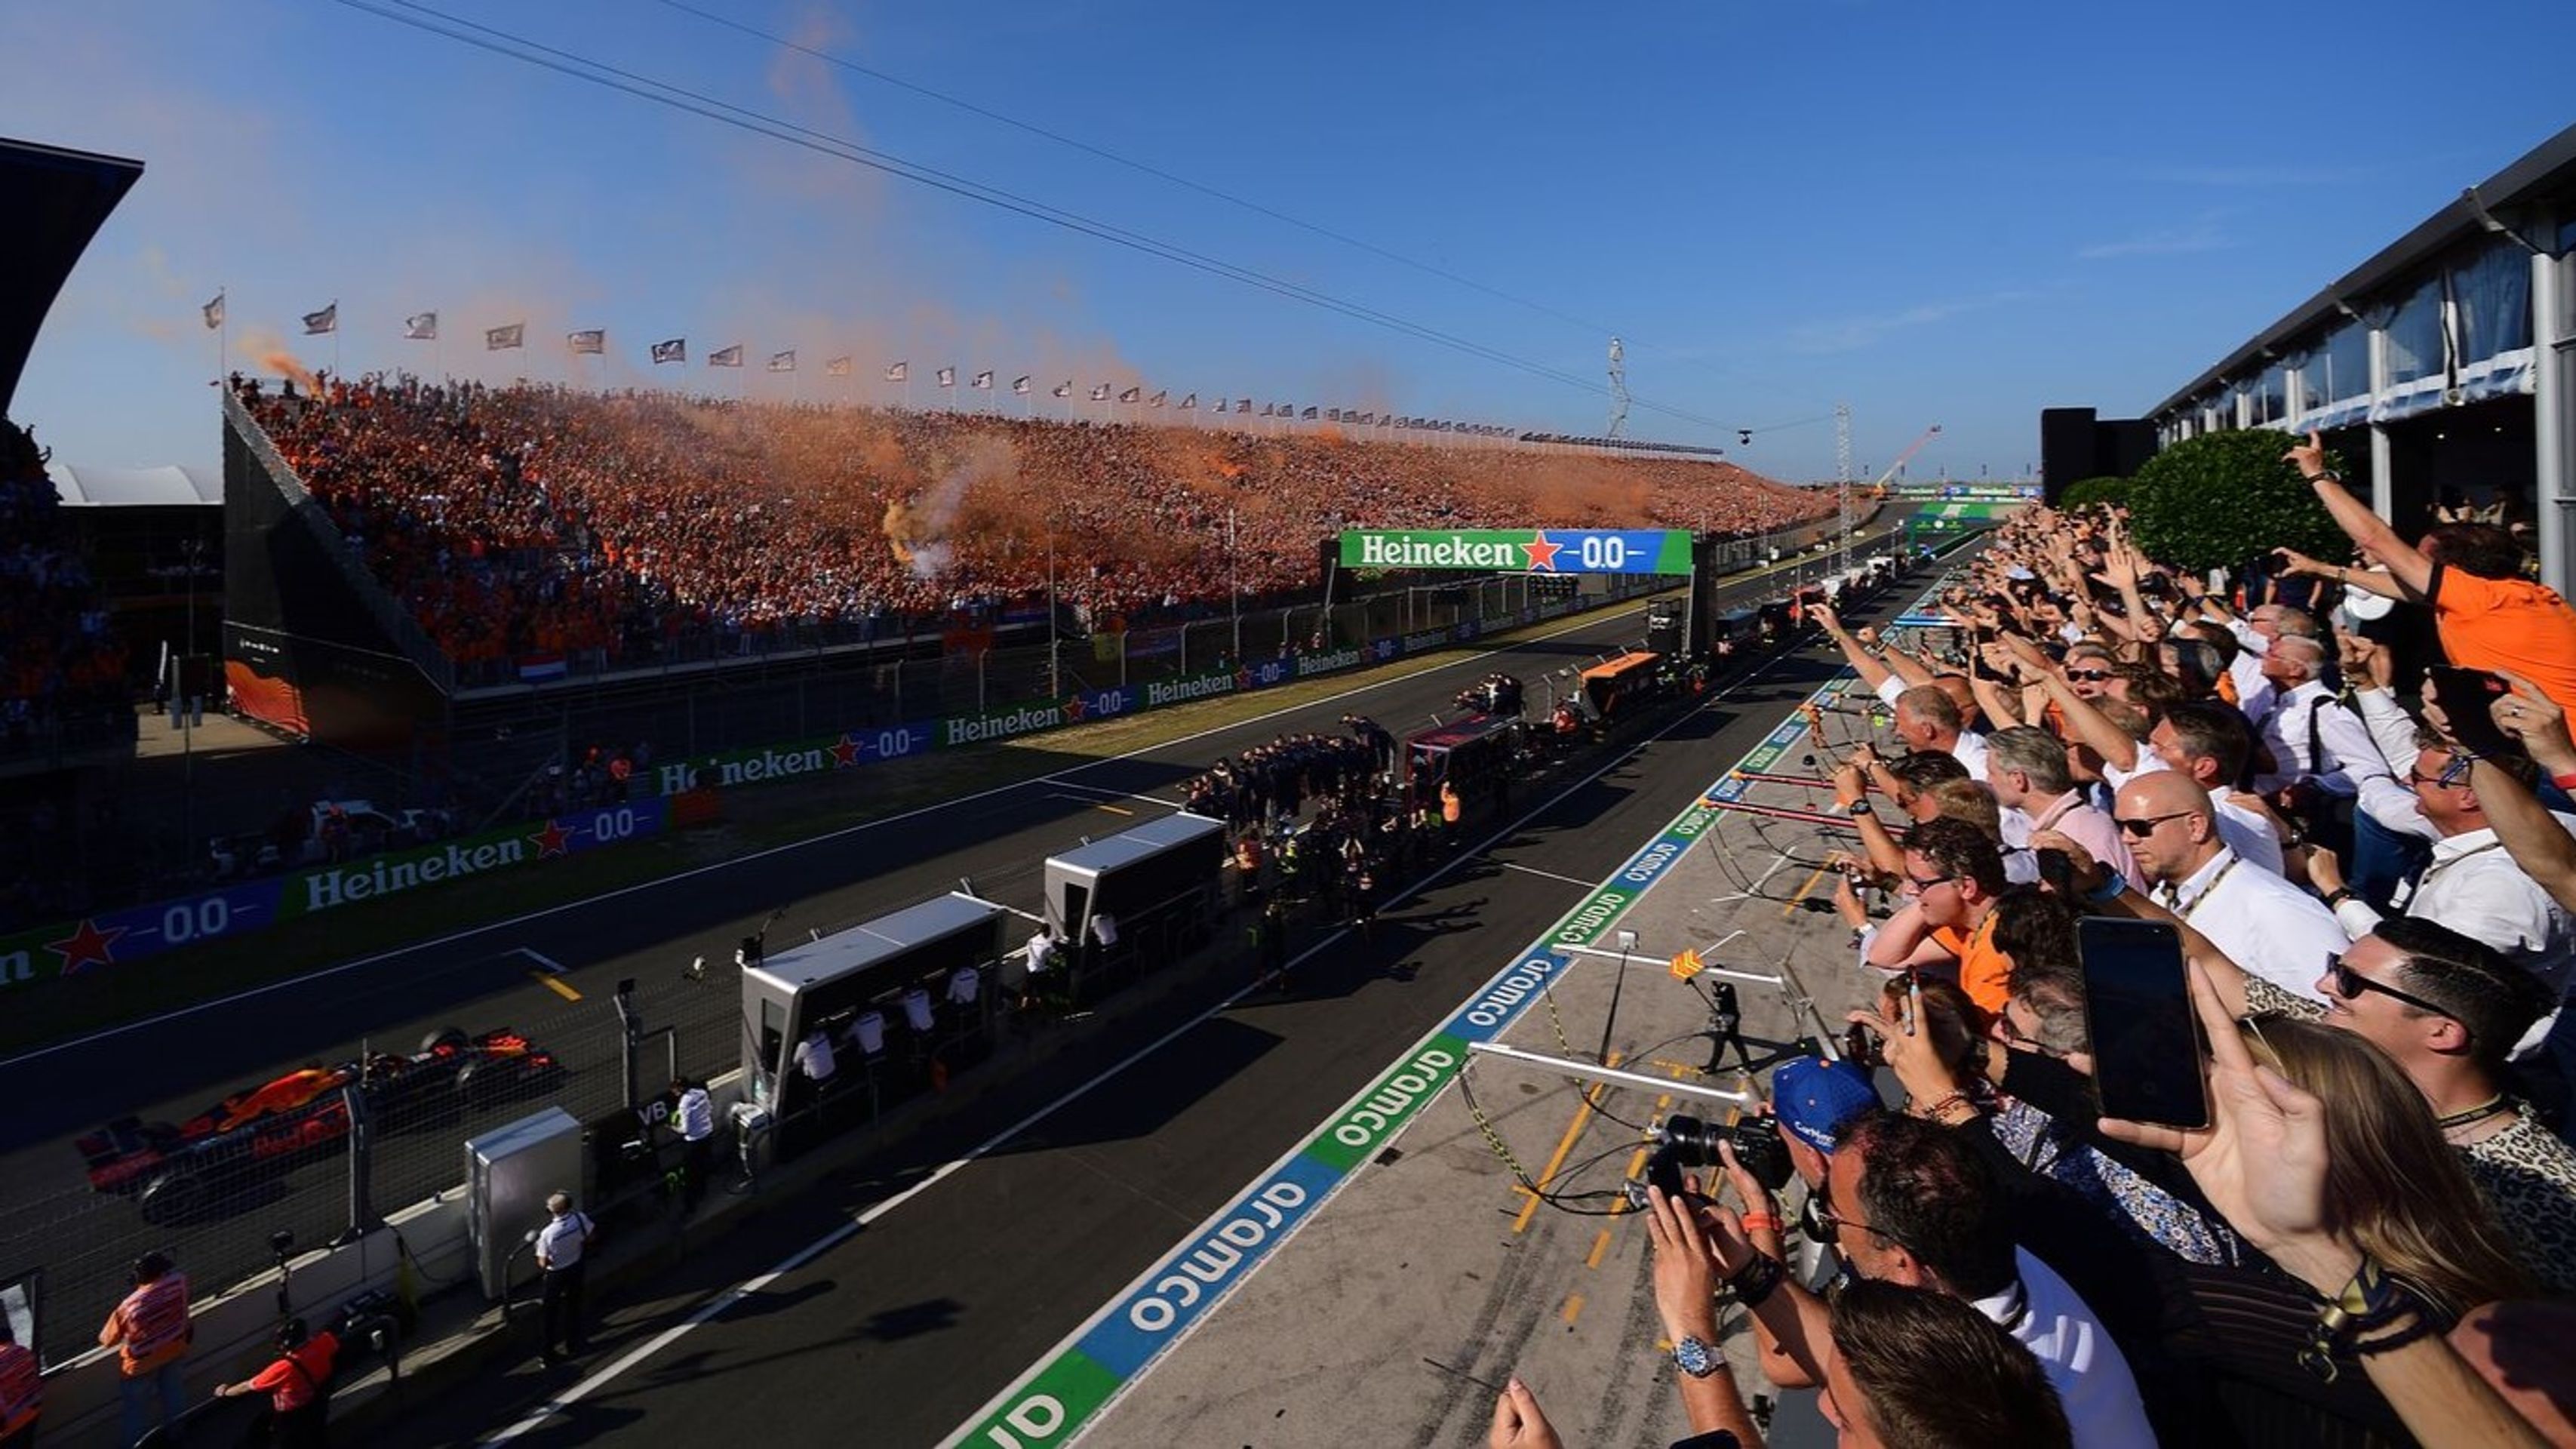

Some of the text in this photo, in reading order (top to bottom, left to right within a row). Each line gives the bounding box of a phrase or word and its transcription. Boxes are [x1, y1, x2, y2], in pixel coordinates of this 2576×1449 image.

[1362, 536, 1515, 566] Heineken
[1148, 672, 1234, 706] Heineken
[947, 707, 1060, 745] Heineken
[659, 747, 824, 795] Hneken
[306, 838, 527, 913] Heineken
[1625, 843, 1678, 881] aramco
[1563, 892, 1626, 943] aramco
[1467, 958, 1553, 1026] aramco
[1335, 1050, 1455, 1146] aramco
[1130, 1183, 1307, 1332] aramco
